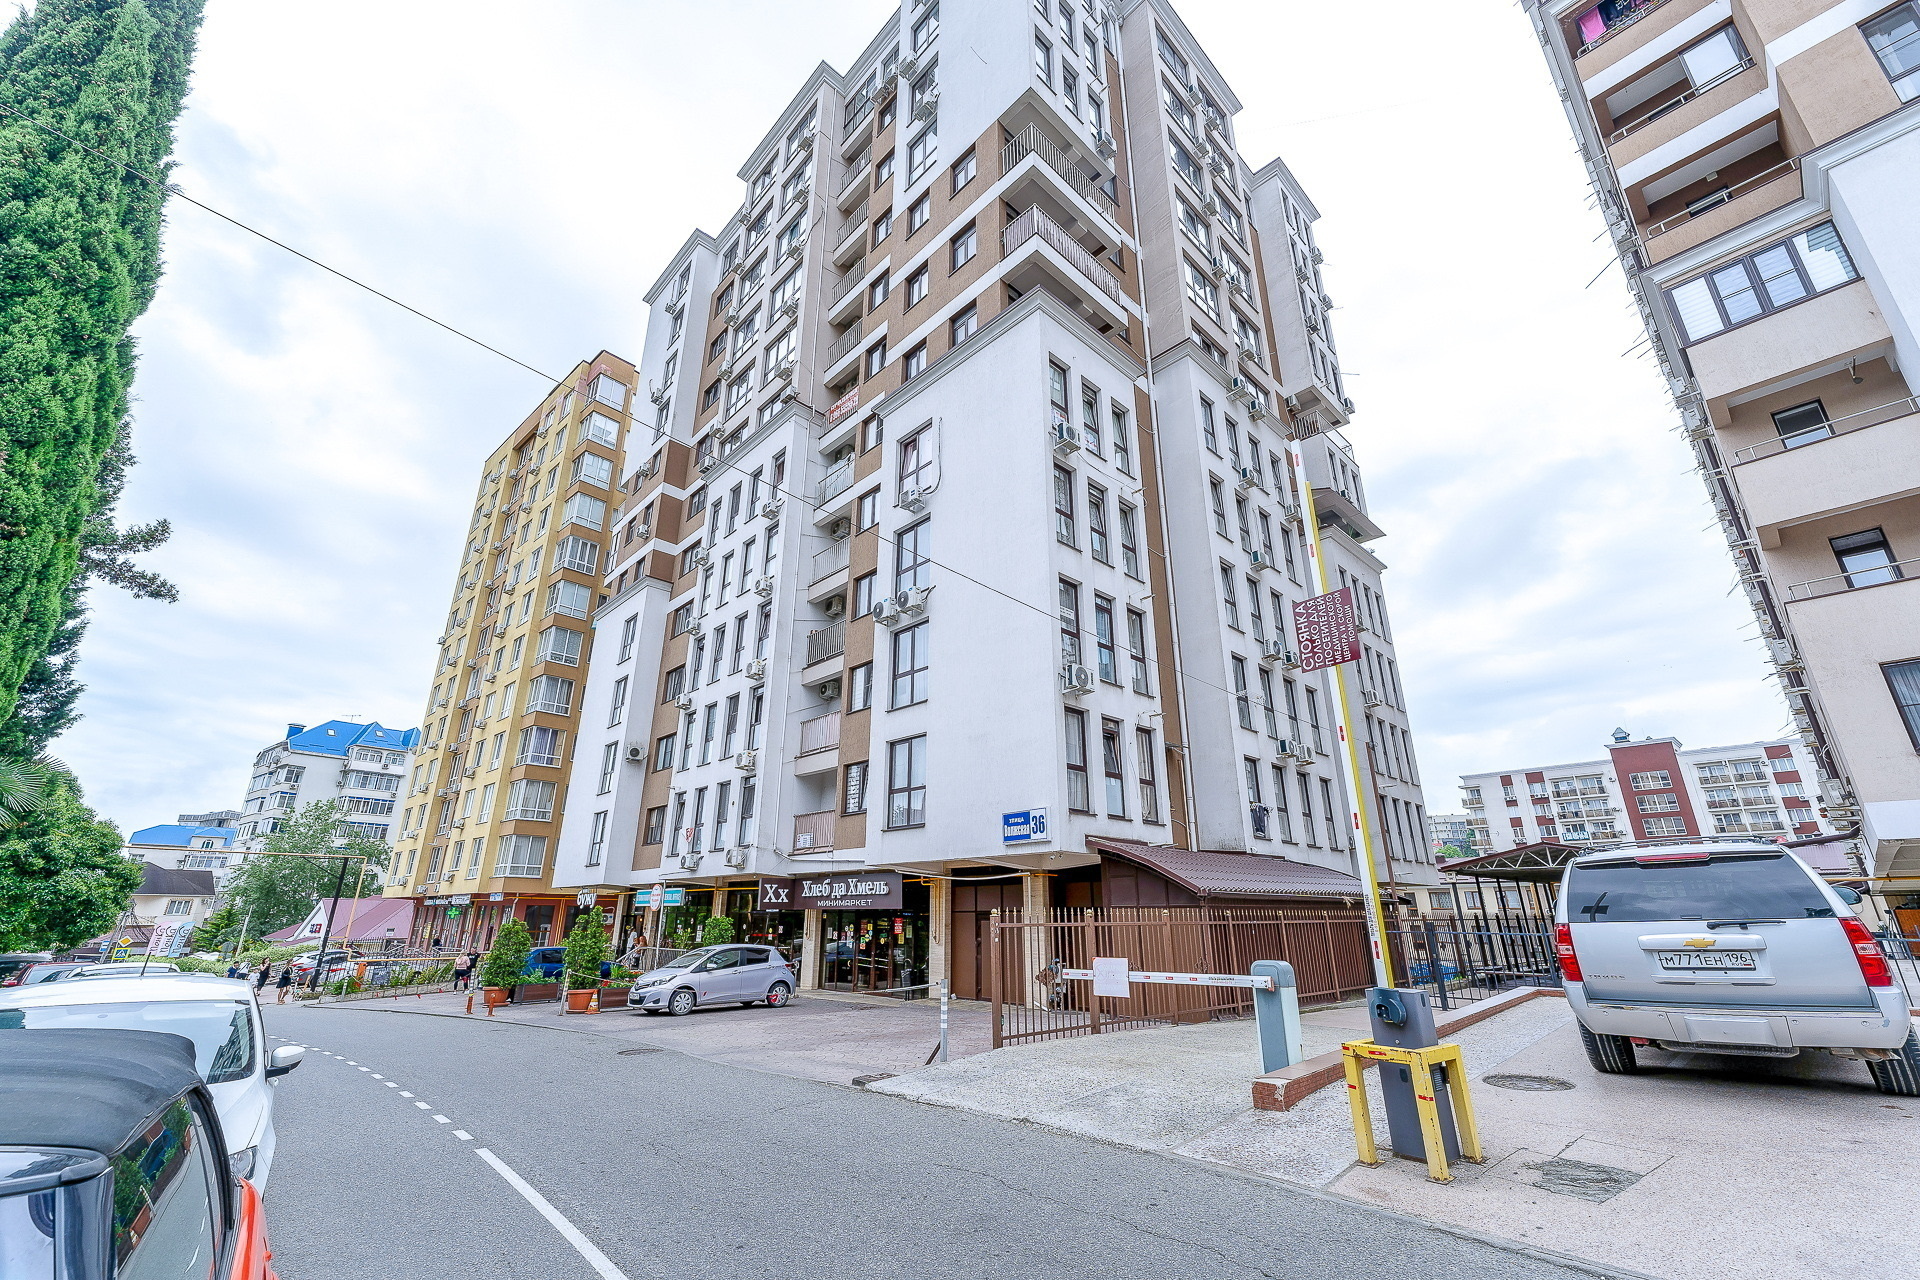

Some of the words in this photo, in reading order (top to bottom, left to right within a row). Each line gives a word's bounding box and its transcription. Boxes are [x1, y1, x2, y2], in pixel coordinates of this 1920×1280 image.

[1307, 600, 1319, 622] ДЛЯ
[1333, 591, 1345, 623] СКОРОЙ
[1317, 596, 1335, 666] ПОСЕТИТЕЛЕЙ
[1326, 594, 1343, 663] МЕДИЦИНСКОГО
[1345, 604, 1356, 642] ПОМОЩИ
[1295, 603, 1314, 670] СТОЯНКА
[1310, 625, 1324, 667] ТОЛЬКО
[1341, 633, 1352, 660] ЦЕНТРА
[1009, 816, 1025, 824] УЛИЦА
[1032, 815, 1045, 834] 36
[763, 884, 789, 903] Хх
[802, 879, 831, 897] Хлеб
[831, 883, 848, 899] да
[847, 878, 889, 896] Хмель
[817, 899, 873, 907] МИНИМАРКЕТ
[1664, 953, 1724, 966] М771ЕН
[1724, 953, 1748, 963] 196
